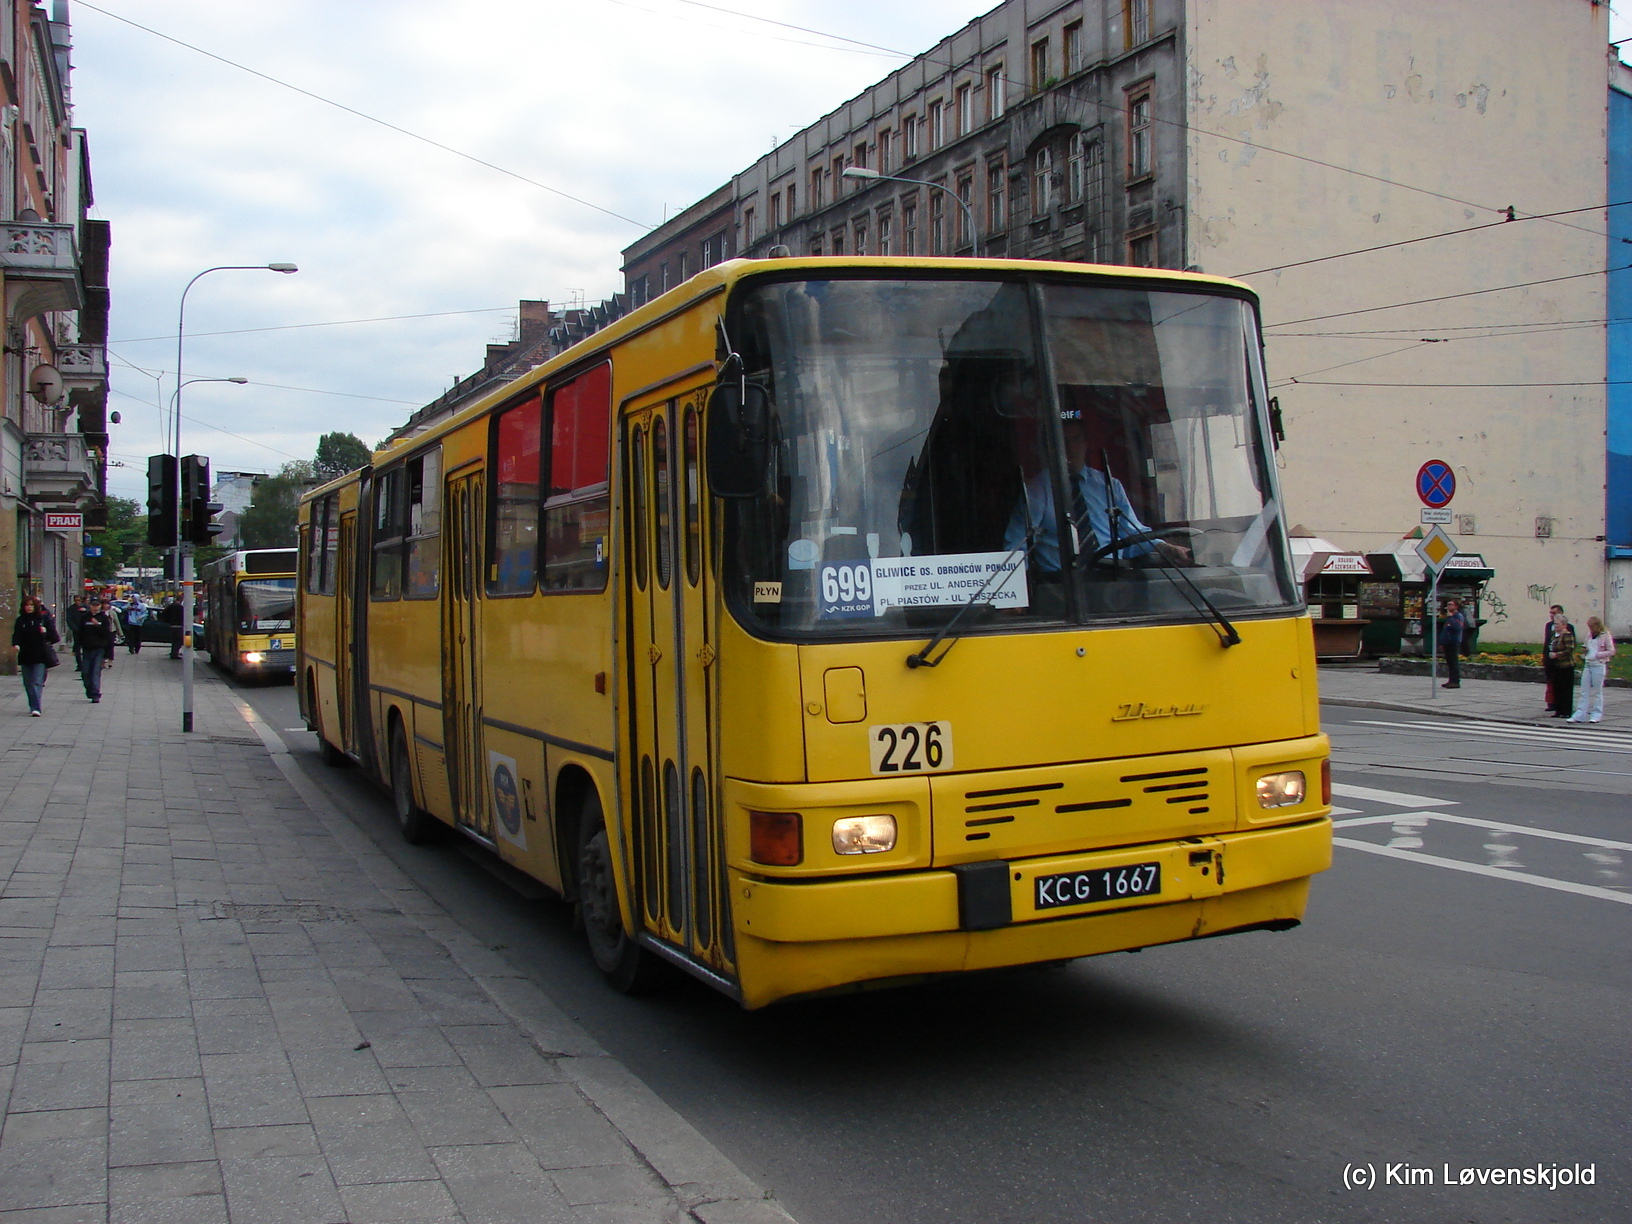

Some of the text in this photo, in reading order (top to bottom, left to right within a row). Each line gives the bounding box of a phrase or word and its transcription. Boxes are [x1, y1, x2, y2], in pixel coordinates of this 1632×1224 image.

[876, 566, 916, 578] GLIWICE
[920, 567, 933, 576] OS.
[937, 563, 982, 575] OBROŃCÓW
[1447, 560, 1481, 568] PAPIEROSY
[755, 587, 779, 596] PŁYN
[822, 565, 872, 603] 699
[904, 579, 992, 591] PRZEZ UL. ANDERSA
[880, 598, 895, 607] PL.
[898, 595, 940, 605] PIASTÓW
[951, 594, 966, 602] UL.
[968, 591, 1017, 601] TOSZECKĄ
[878, 725, 943, 772] 226
[1039, 866, 1157, 905] KCG 1667
